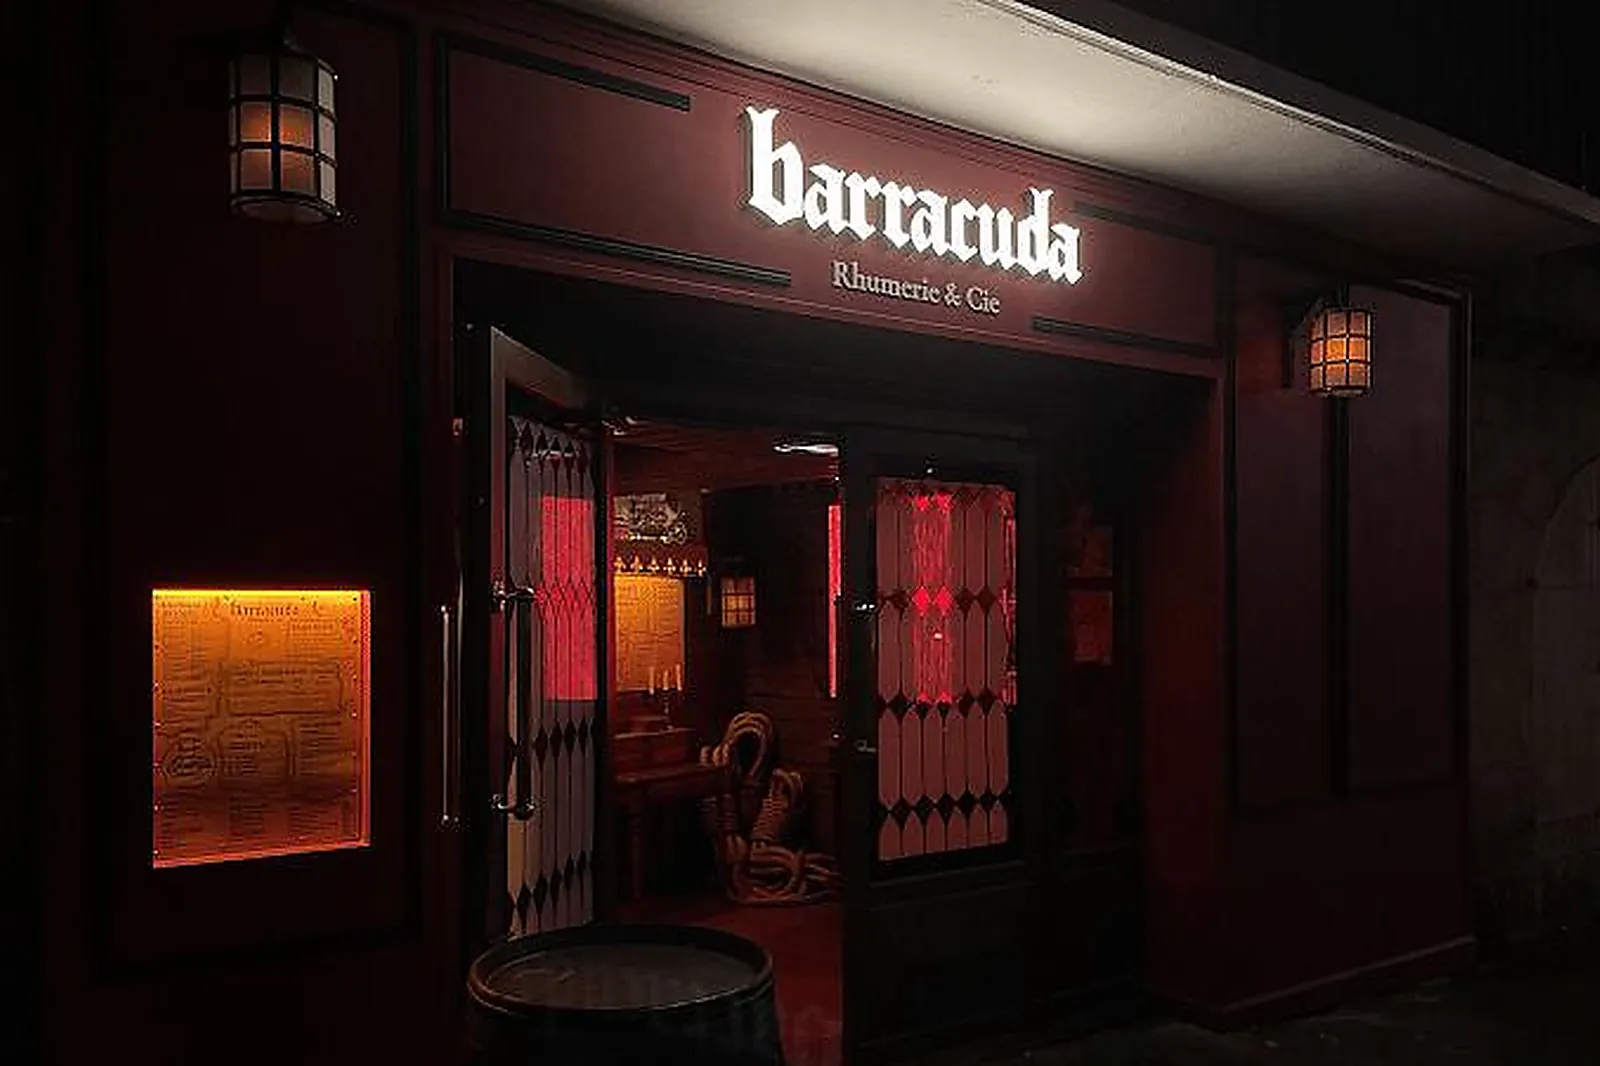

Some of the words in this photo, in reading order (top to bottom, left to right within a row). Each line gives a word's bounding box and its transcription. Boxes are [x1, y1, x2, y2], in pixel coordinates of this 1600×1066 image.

[745, 106, 1083, 285] barracuda
[832, 260, 942, 305] Rhumerie
[944, 283, 963, 307] &
[966, 285, 1001, 315] Cie
